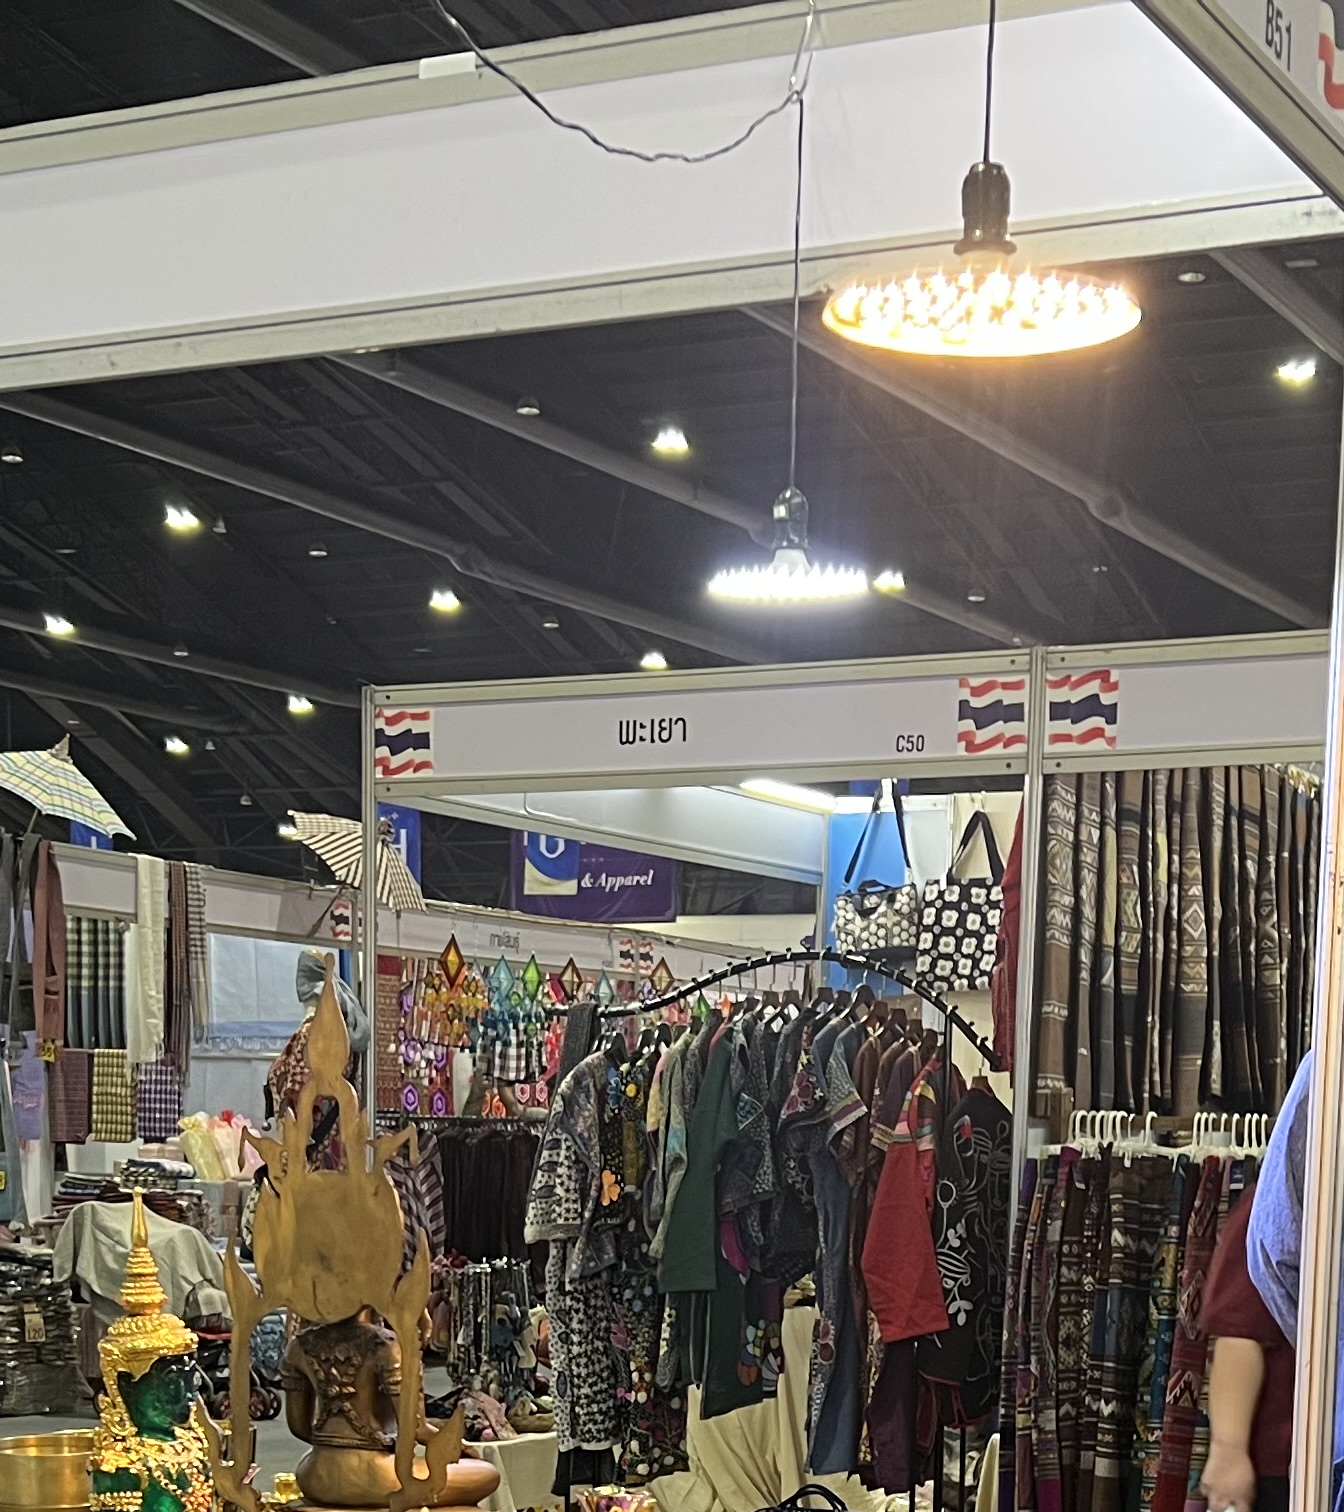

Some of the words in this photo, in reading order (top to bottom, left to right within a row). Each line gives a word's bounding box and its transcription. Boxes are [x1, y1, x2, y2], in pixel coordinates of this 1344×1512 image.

[1265, 0, 1292, 72] B51
[618, 716, 688, 746] พะเยา
[895, 734, 926, 754] C50
[581, 873, 594, 888] &
[594, 869, 654, 893] Apparel
